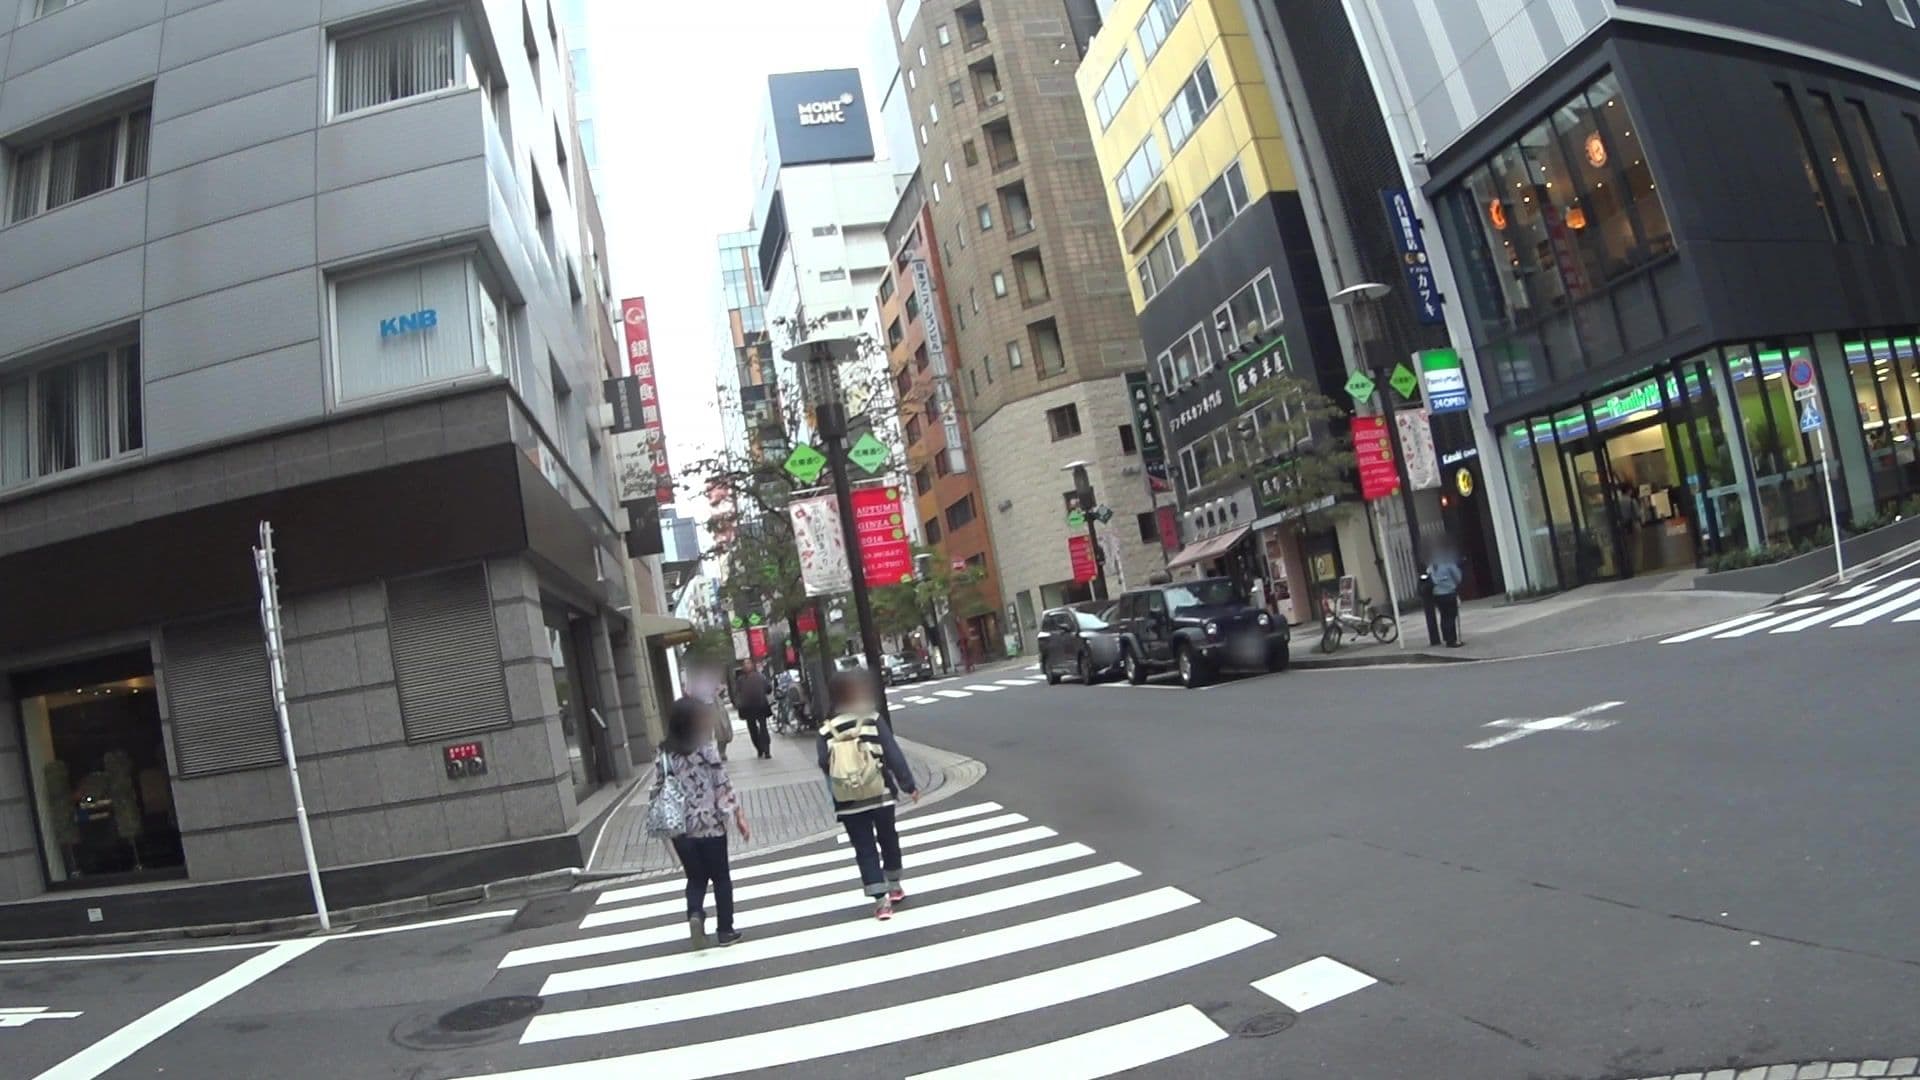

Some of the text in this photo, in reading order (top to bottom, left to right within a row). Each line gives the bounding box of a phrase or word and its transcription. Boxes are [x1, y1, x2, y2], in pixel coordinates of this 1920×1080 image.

[798, 99, 841, 114] MONT
[799, 110, 845, 126] BLANC
[380, 309, 438, 337] KNB
[856, 503, 900, 515] AUTUMN
[857, 519, 890, 531] GINZA
